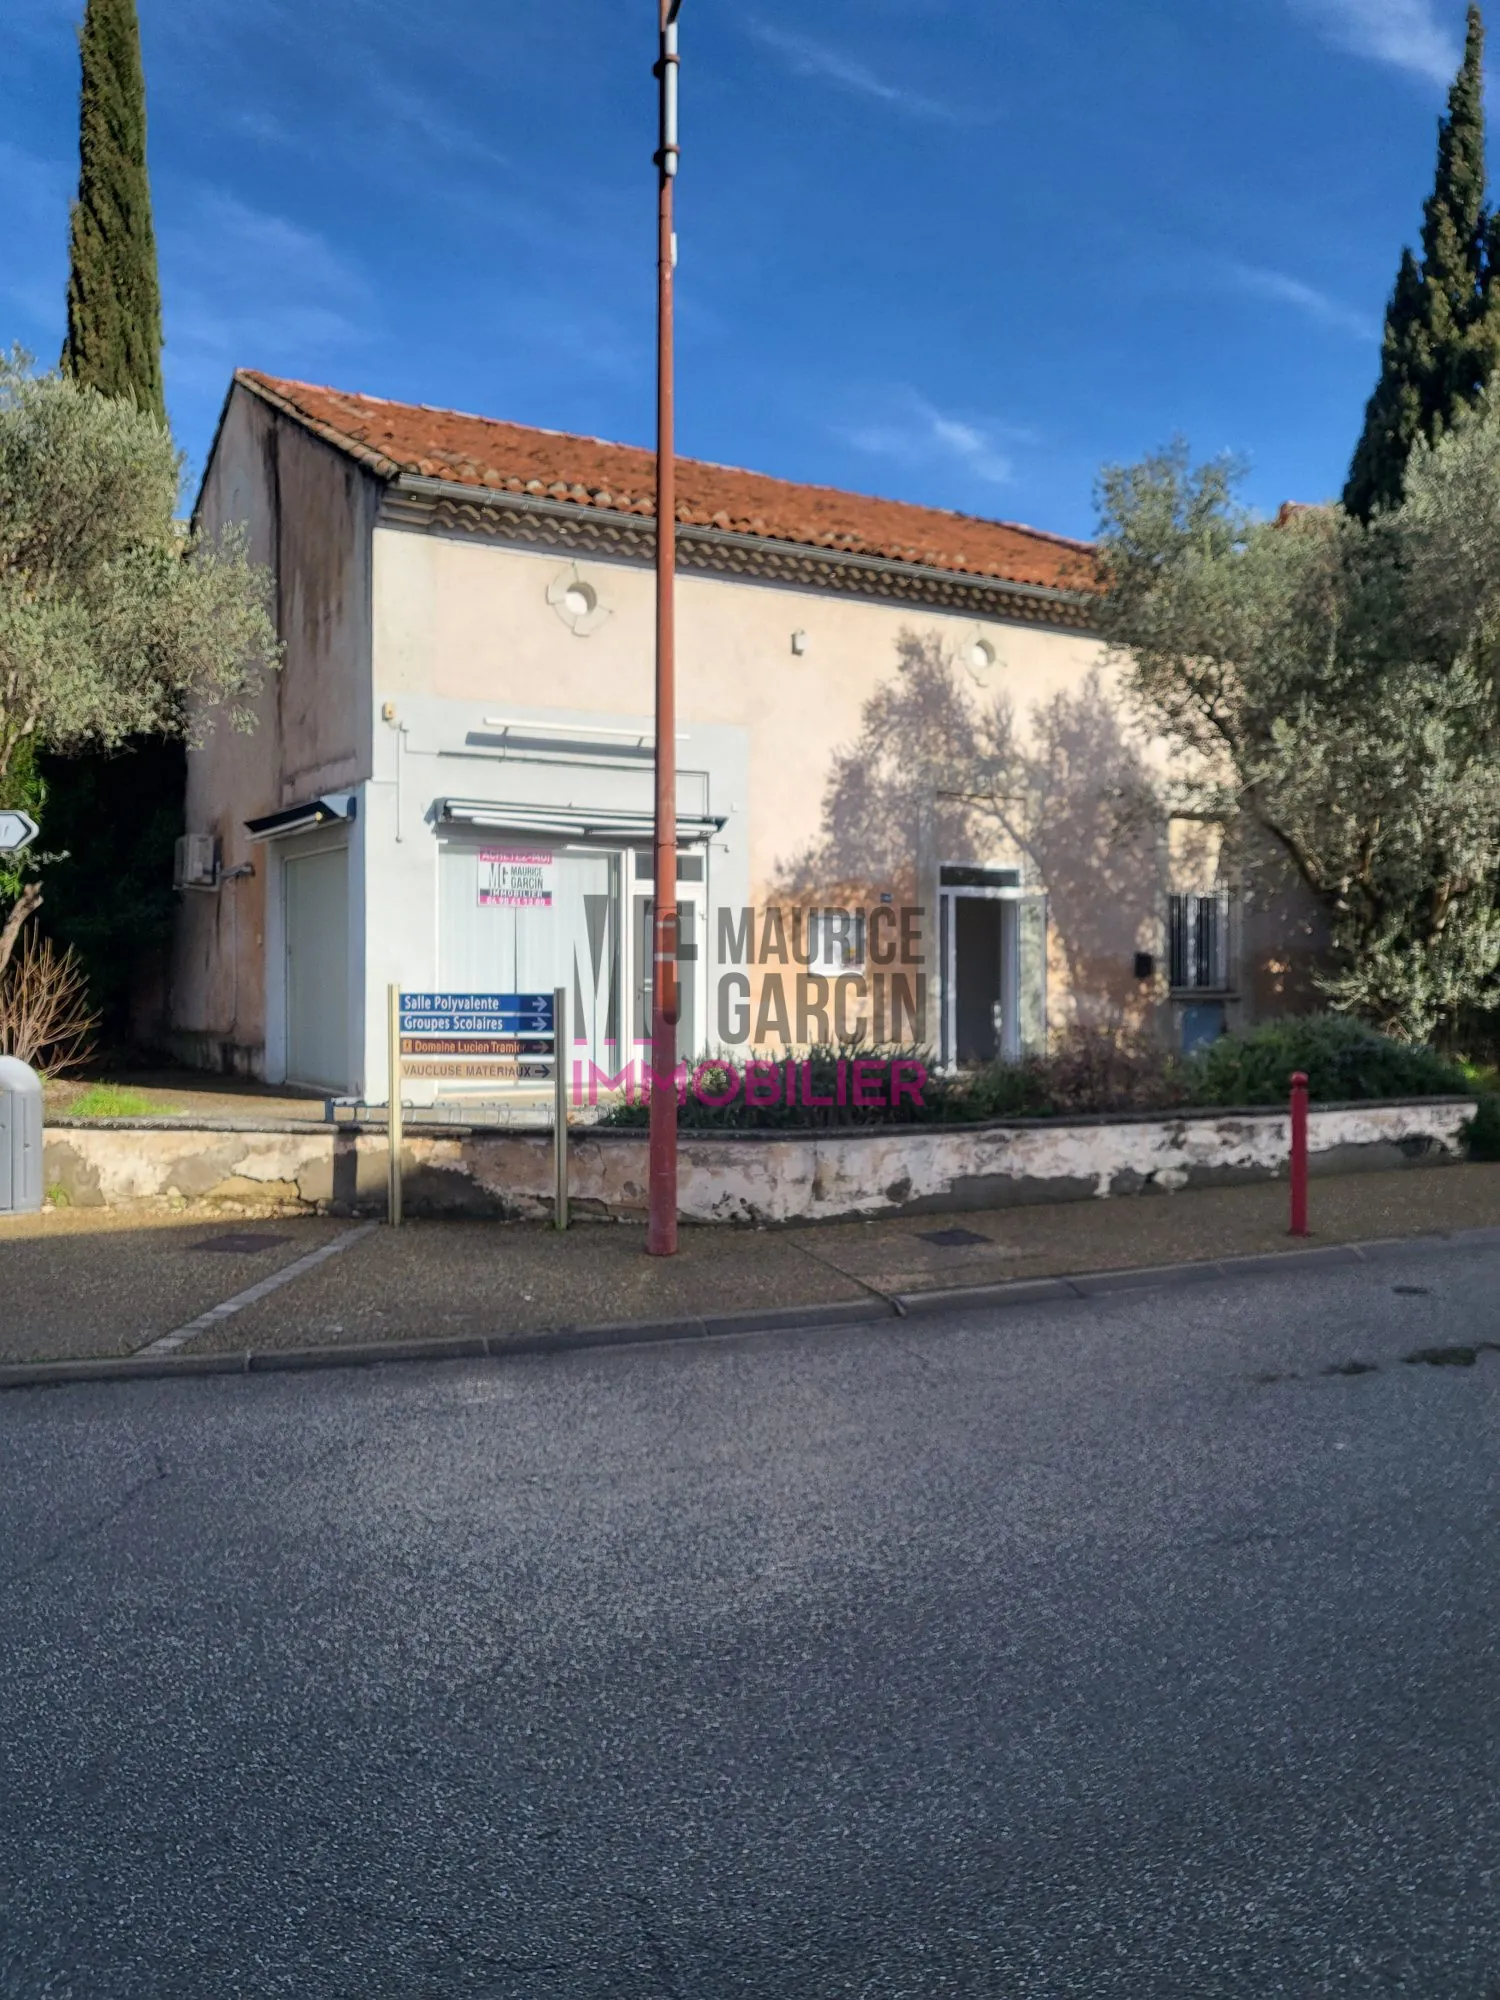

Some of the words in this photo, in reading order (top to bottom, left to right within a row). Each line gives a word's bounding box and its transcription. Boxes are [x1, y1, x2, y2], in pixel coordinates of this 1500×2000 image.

[510, 866, 542, 877] MAURICE
[510, 877, 544, 889] GARCIN
[404, 995, 431, 1010] Salle
[434, 996, 500, 1012] Polyvalente
[404, 1016, 450, 1031] Groupes
[453, 1016, 503, 1030] Scolaires
[414, 1040, 456, 1053] Domaine
[457, 1040, 489, 1053] Lucien
[403, 1065, 462, 1076] VAUCLUSE
